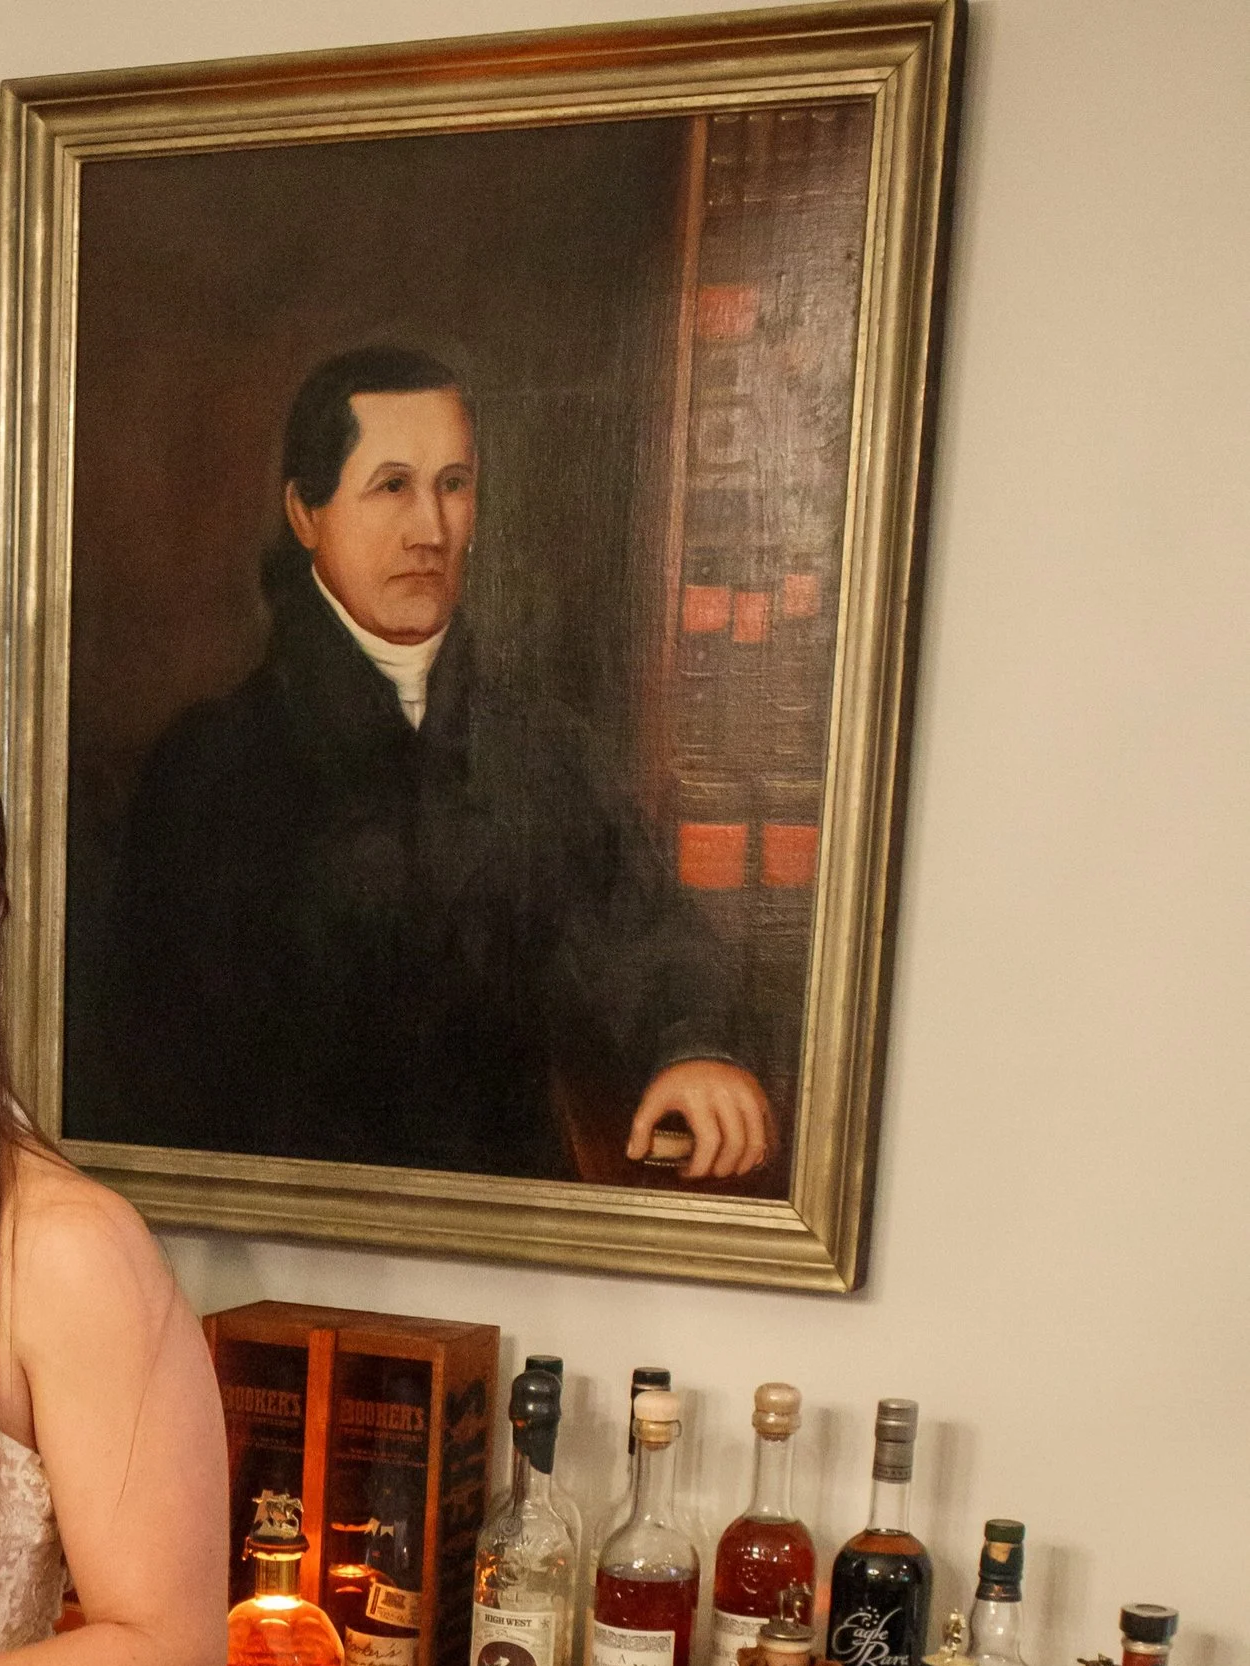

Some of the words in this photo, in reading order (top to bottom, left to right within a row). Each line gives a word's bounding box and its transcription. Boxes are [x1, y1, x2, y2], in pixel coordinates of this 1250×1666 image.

[485, 1613, 505, 1625] HIGH
[506, 1617, 533, 1628] WEST
[618, 1653, 627, 1665] A
